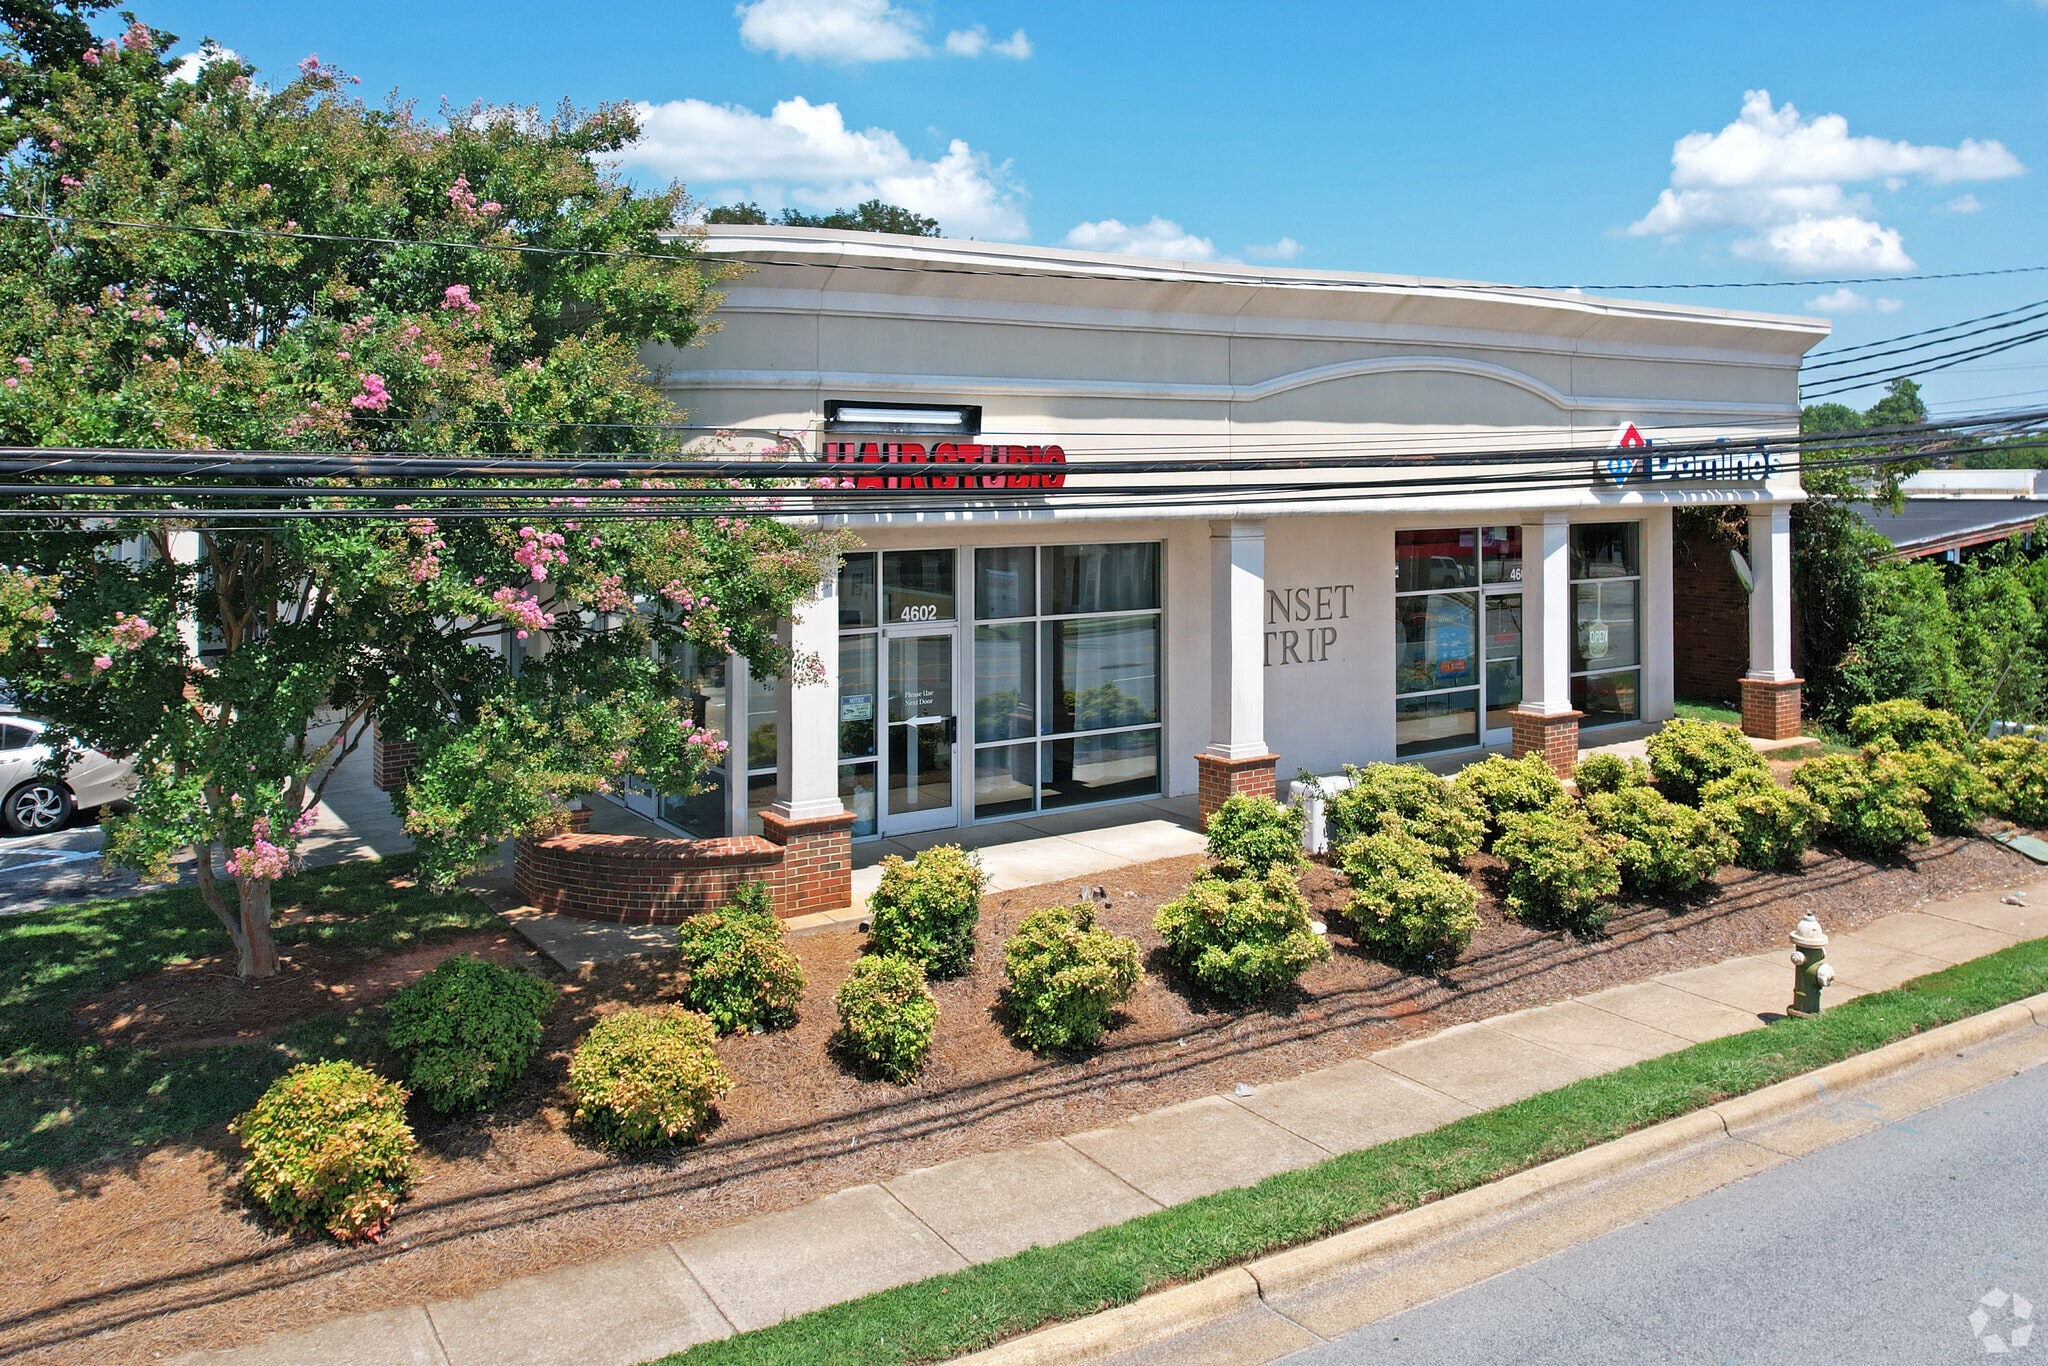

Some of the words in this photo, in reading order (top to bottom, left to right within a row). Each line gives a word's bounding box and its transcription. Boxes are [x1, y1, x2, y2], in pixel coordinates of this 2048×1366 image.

[1510, 568, 1523, 581] 46
[901, 604, 937, 621] 4602
[1266, 585, 1354, 624] NSET
[1589, 629, 1608, 644] OPEN
[1264, 627, 1337, 666] TRIP
